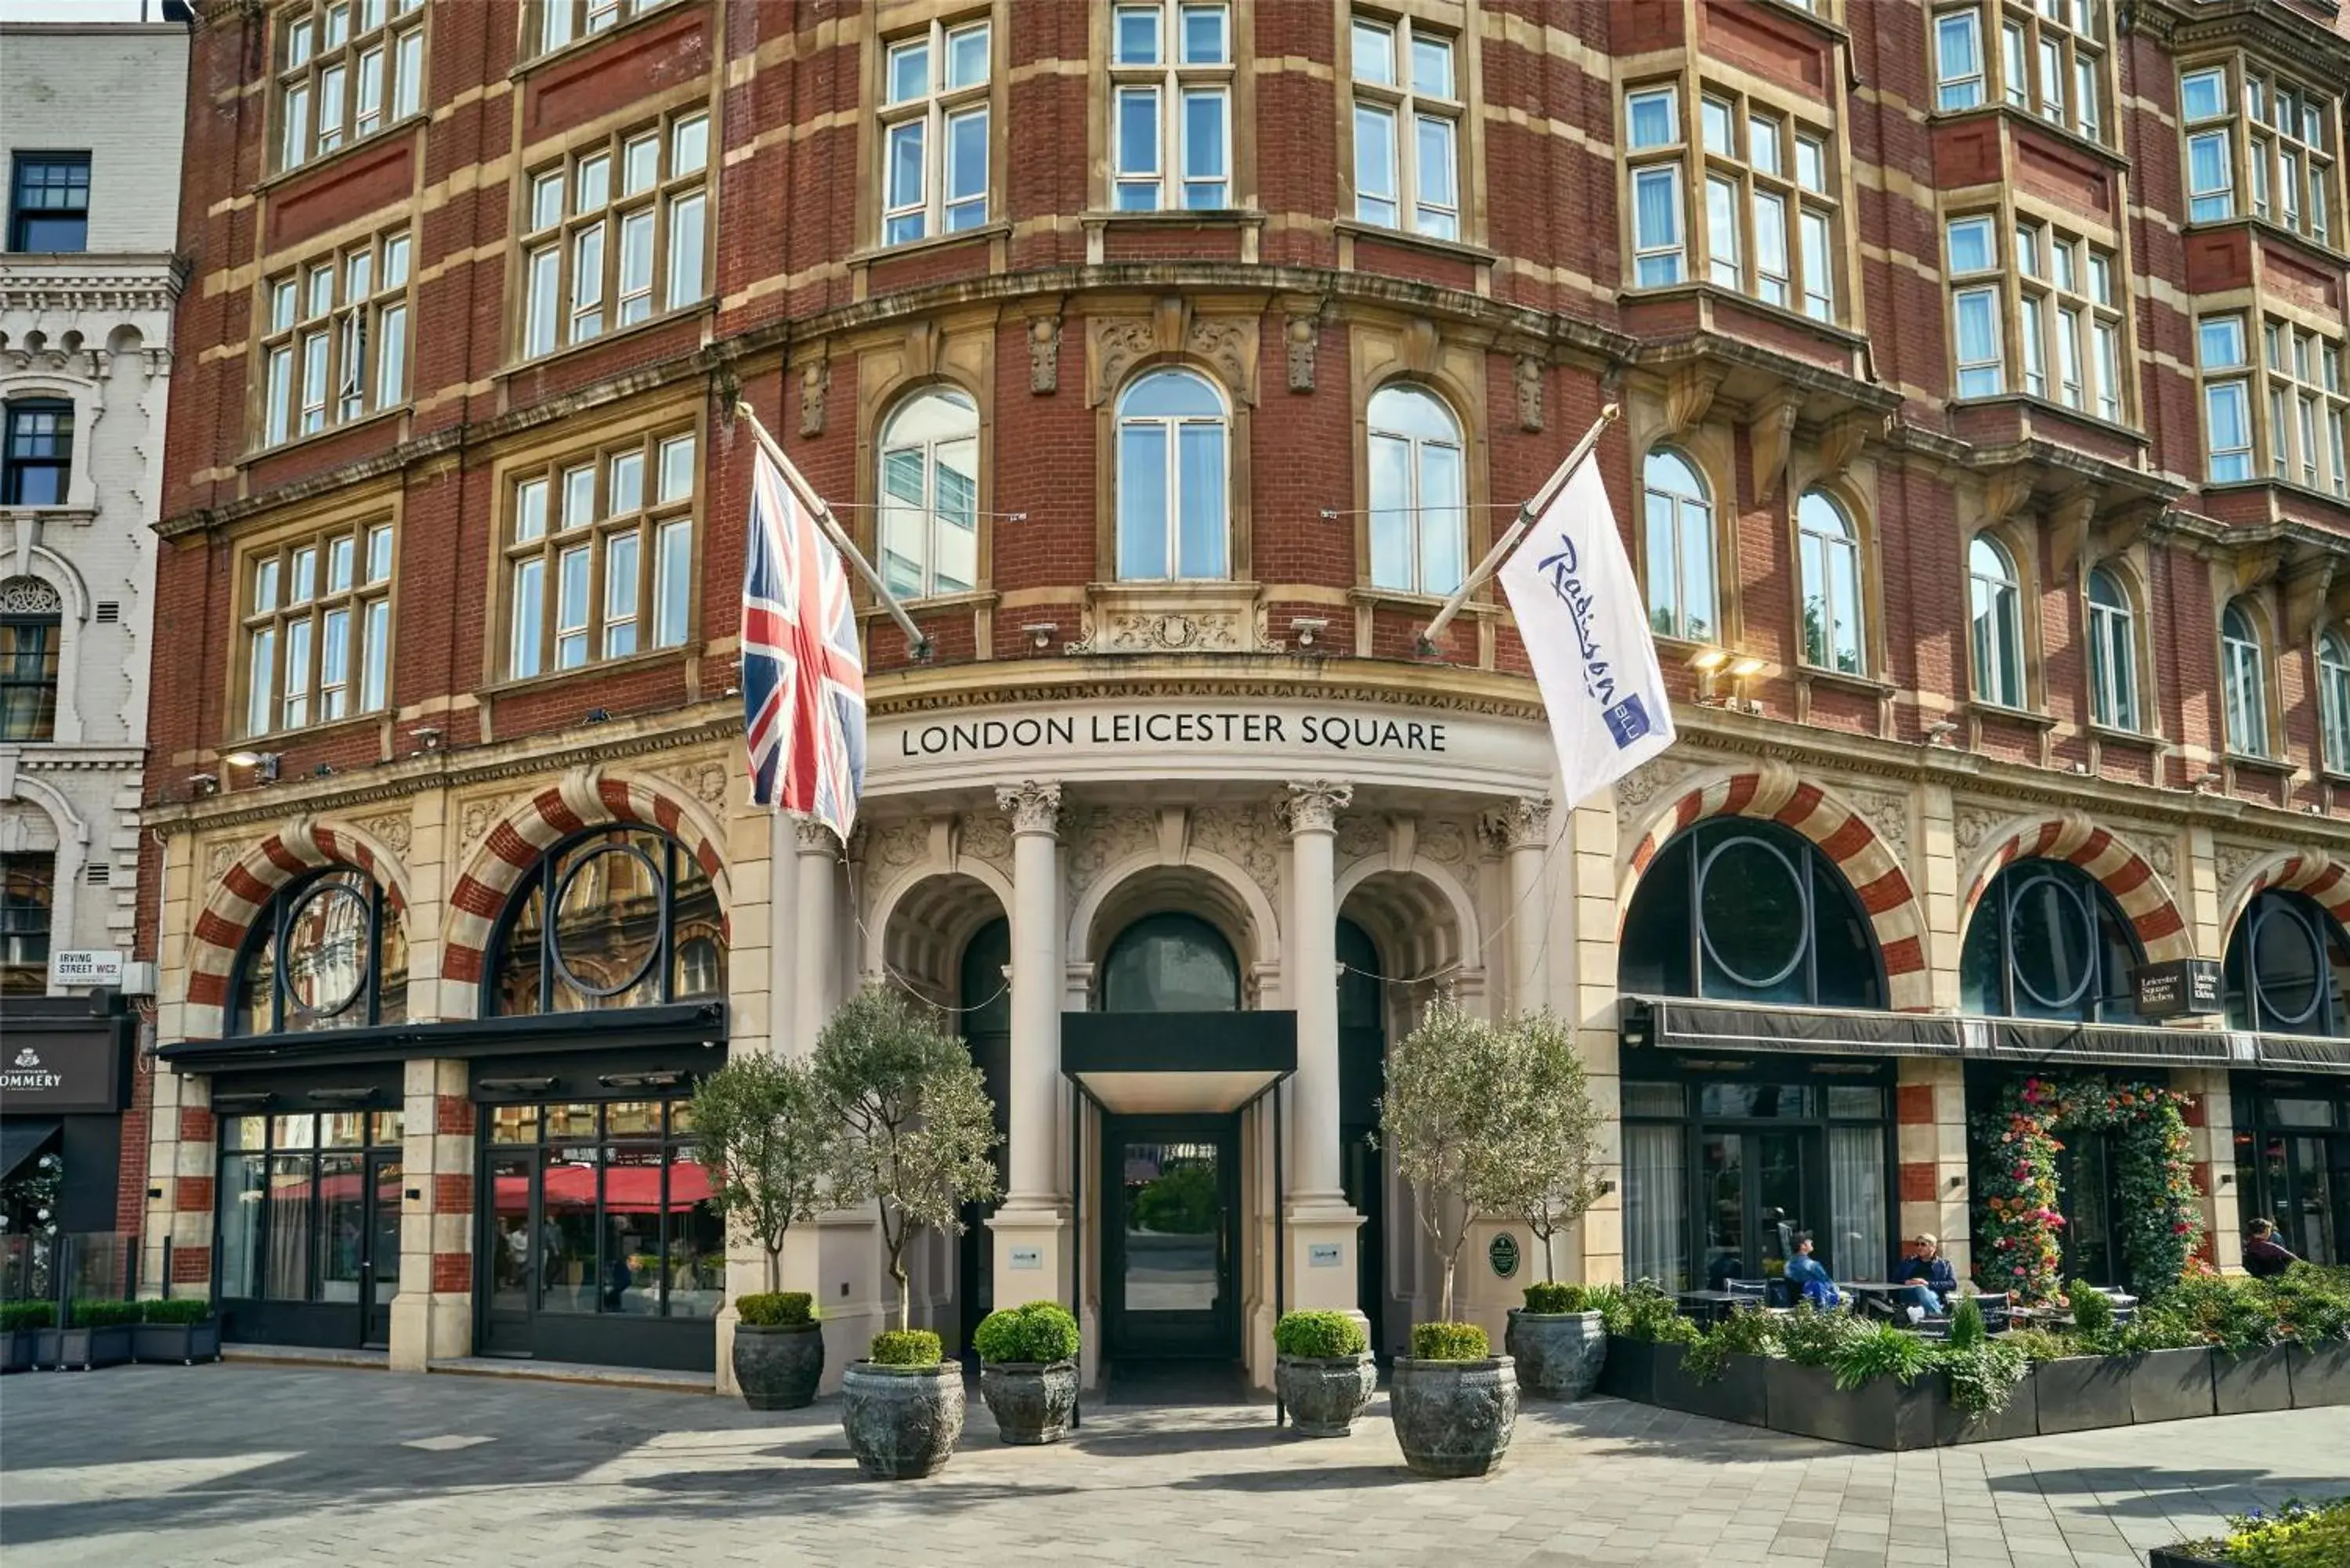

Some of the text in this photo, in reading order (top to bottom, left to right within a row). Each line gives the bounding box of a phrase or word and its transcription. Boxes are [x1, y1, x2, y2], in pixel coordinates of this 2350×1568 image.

[1538, 533, 1614, 706] Radisson
[1614, 704, 1640, 739] BLU
[902, 714, 1446, 756] LONDON LEICESTER SQUARE
[60, 953, 92, 963] IRVING
[59, 964, 118, 974] STREET WC2
[2140, 975, 2178, 987] Leicester
[2142, 993, 2175, 1003] Kitchen
